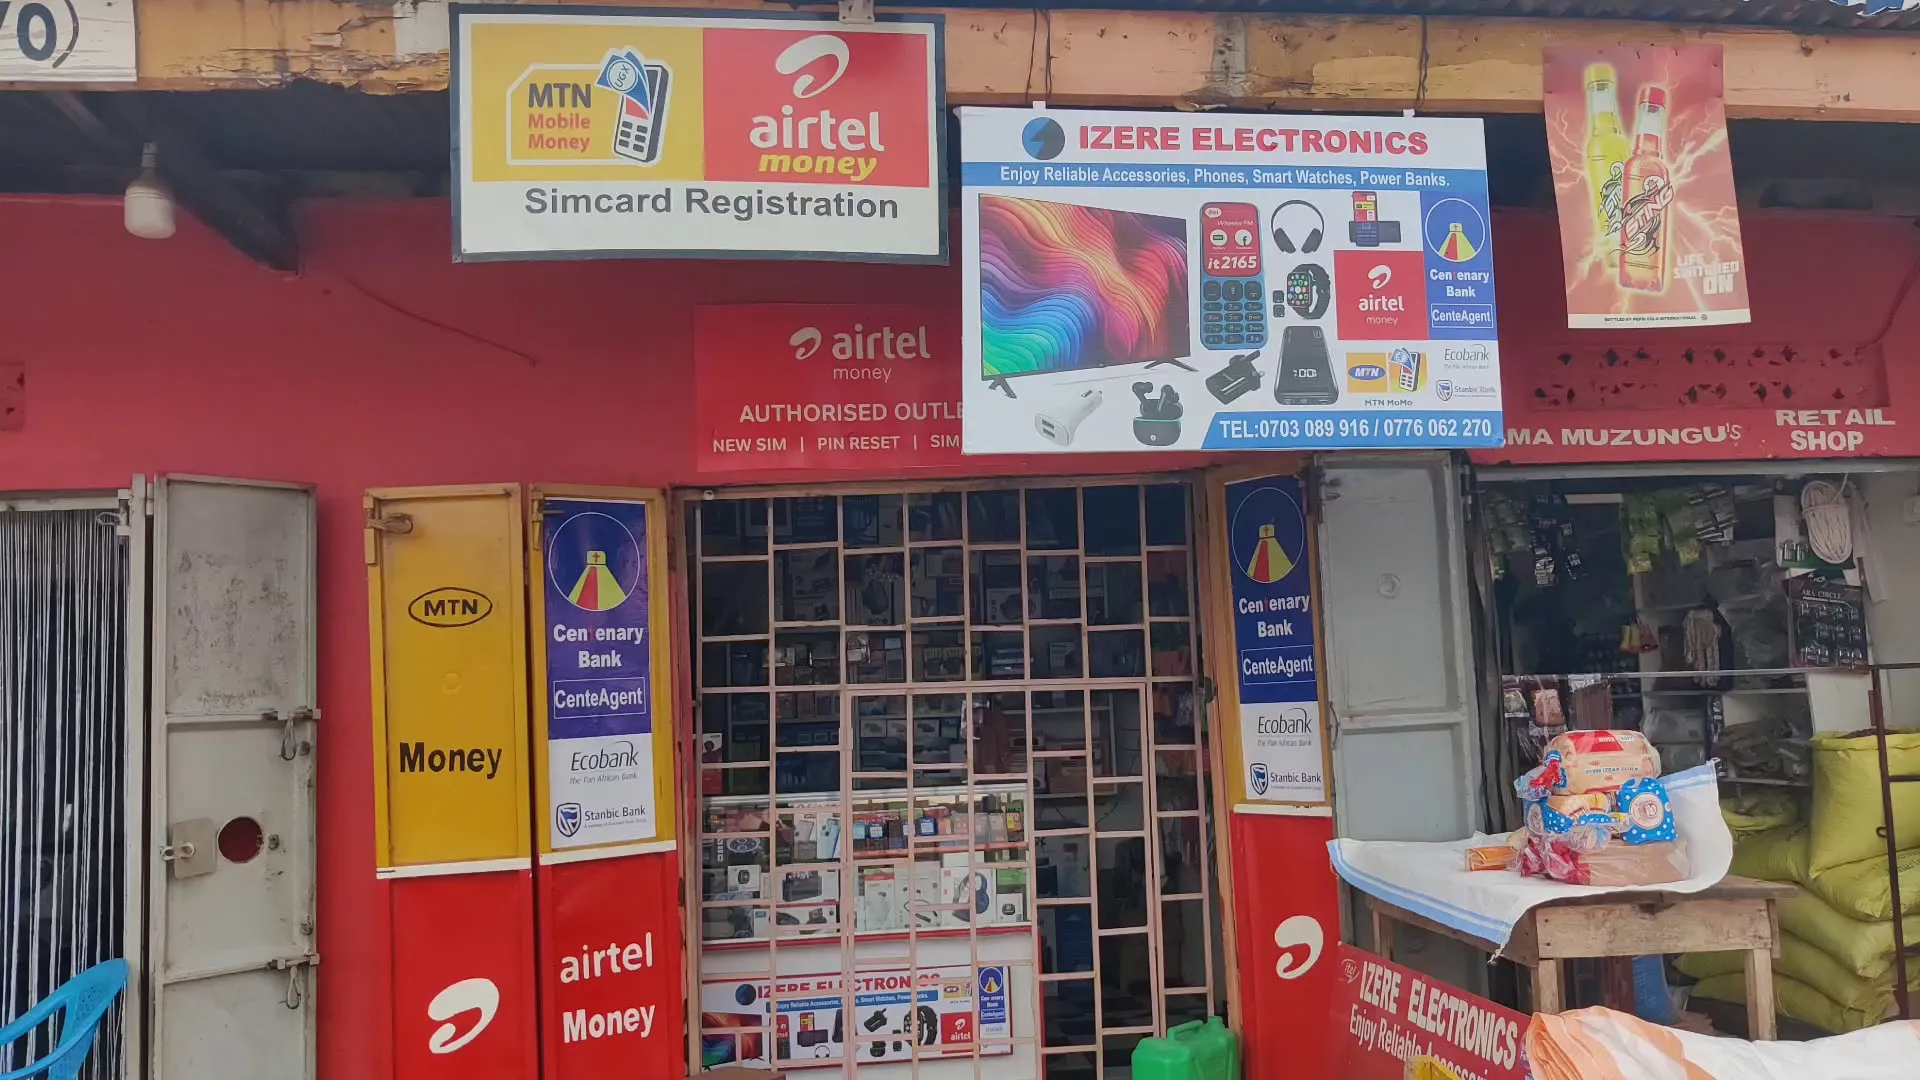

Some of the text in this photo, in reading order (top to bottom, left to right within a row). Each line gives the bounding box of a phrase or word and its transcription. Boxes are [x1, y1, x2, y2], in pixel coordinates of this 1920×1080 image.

[614, 64, 631, 88] UGX
[528, 83, 591, 109] MTN
[528, 113, 591, 131] Mobile
[749, 105, 884, 151] airtel
[528, 133, 591, 153] Money
[1079, 125, 1429, 155] IZERE ELECTRONICS
[758, 151, 877, 181] money
[1000, 166, 1450, 187] Enjoy Reliable Accessories, Phones, Smart Watches, Power Banks.
[525, 187, 898, 221] Simcard Registration
[1207, 255, 1257, 270] it2165
[1446, 285, 1476, 298] Bank
[1703, 274, 1734, 295] ON
[1358, 294, 1405, 311] airtel
[1366, 315, 1398, 325] money
[1431, 308, 1491, 325] CenteAgent
[831, 324, 931, 360] airtel
[1444, 345, 1490, 361] Ecobank
[833, 368, 892, 384] money
[1354, 367, 1379, 377] MTN
[739, 403, 887, 423] AUTHORISED
[1365, 399, 1413, 407] MTN MoMo
[1219, 419, 1300, 438] TEL:0703
[1304, 419, 1335, 437] 089
[1339, 419, 1369, 437] 916
[1383, 418, 1424, 437] 0776
[1428, 418, 1458, 437] 062
[1462, 418, 1492, 437] 270
[1775, 409, 1896, 427] RETAIL
[713, 434, 960, 453] NEW SIM PIN RESET SIM
[1503, 428, 1554, 446] MA
[1791, 430, 1864, 452] SHOP
[424, 599, 478, 617] MTN
[1257, 619, 1293, 637] Bank
[578, 649, 622, 668] Bank
[1243, 655, 1313, 677] CenteAgent
[554, 686, 643, 711] CenteAgent
[1258, 708, 1312, 733] Ecobank
[400, 741, 502, 780] Money
[571, 741, 639, 771] Ecobank
[1270, 772, 1322, 783] Stanbic Bank
[584, 804, 646, 821] Stanbic Bank
[560, 931, 653, 984] airtel
[563, 1004, 656, 1044] Money
[1359, 960, 1518, 1071] IZERE ELECTRONICS
[950, 1031, 971, 1041] airtel
[1350, 1004, 1378, 1051] Enjoy
